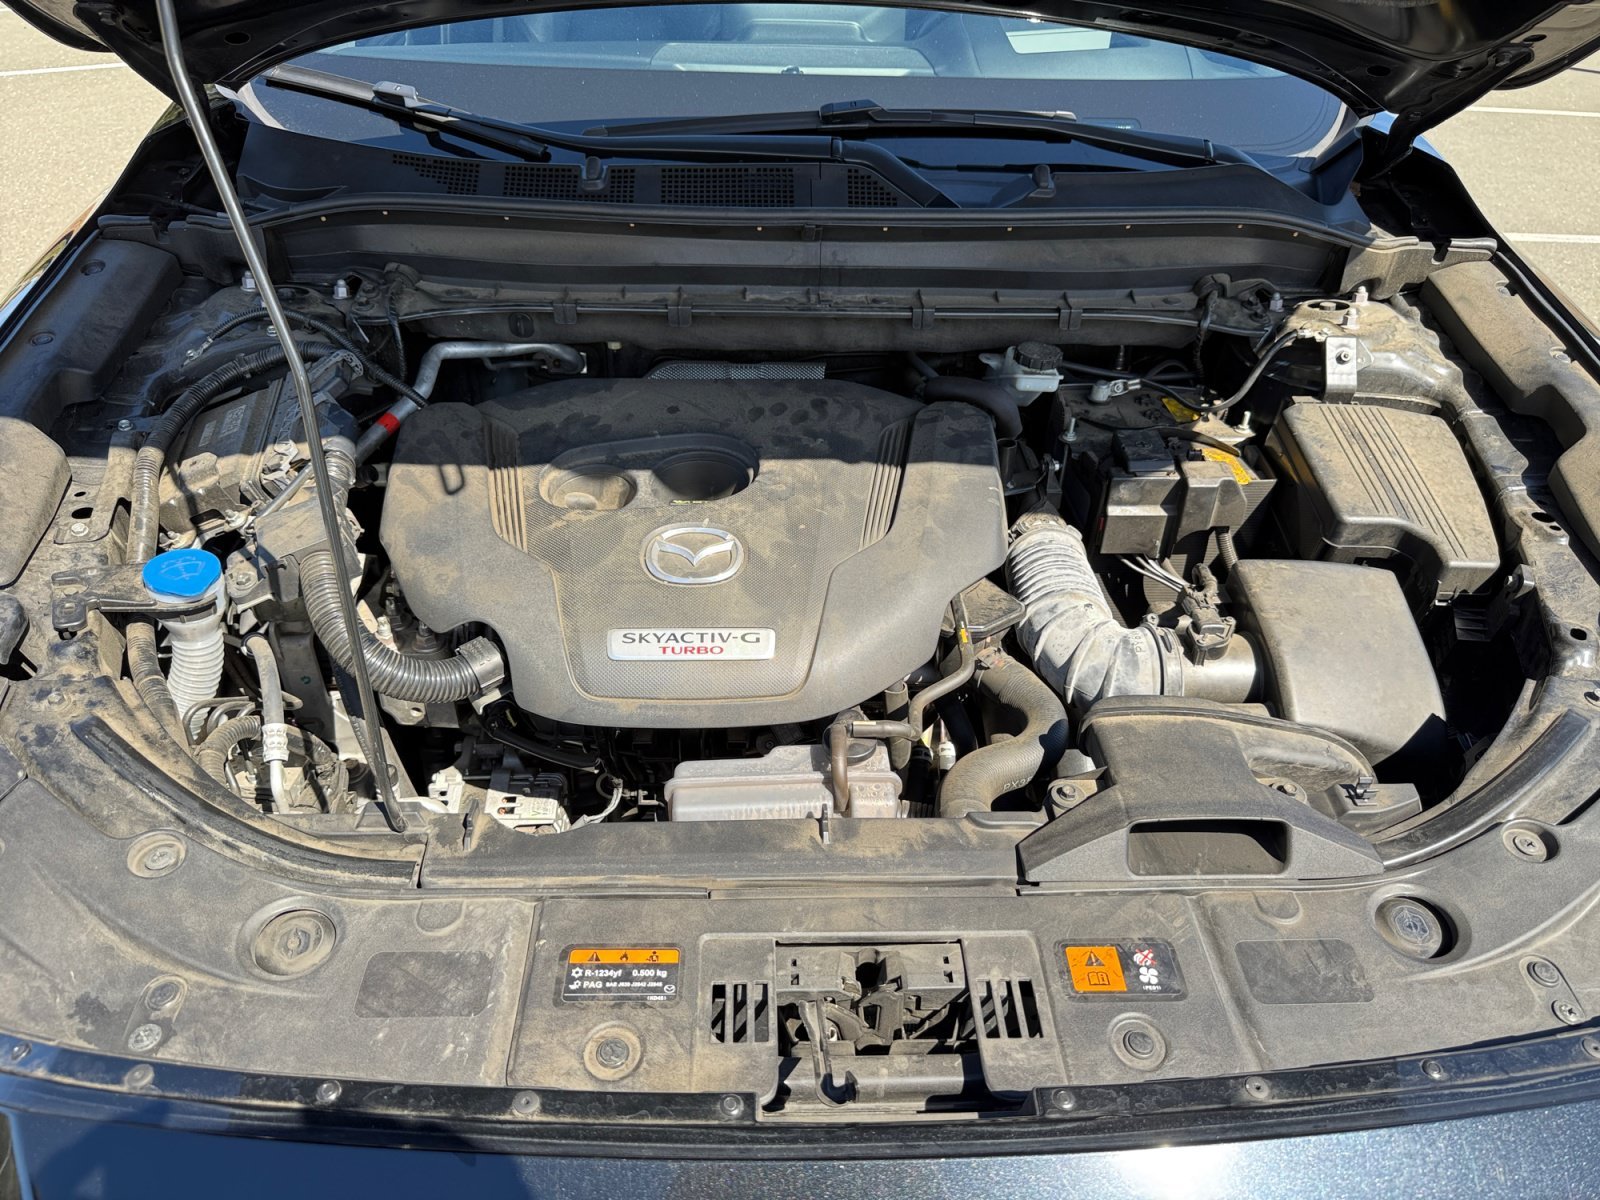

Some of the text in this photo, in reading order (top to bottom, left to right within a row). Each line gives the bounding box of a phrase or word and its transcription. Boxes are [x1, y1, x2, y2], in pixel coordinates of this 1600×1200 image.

[622, 632, 761, 644] SKYACTIV-G
[658, 646, 724, 655] TURBO
[584, 969, 668, 978] R-1234yf 0.500 kg
